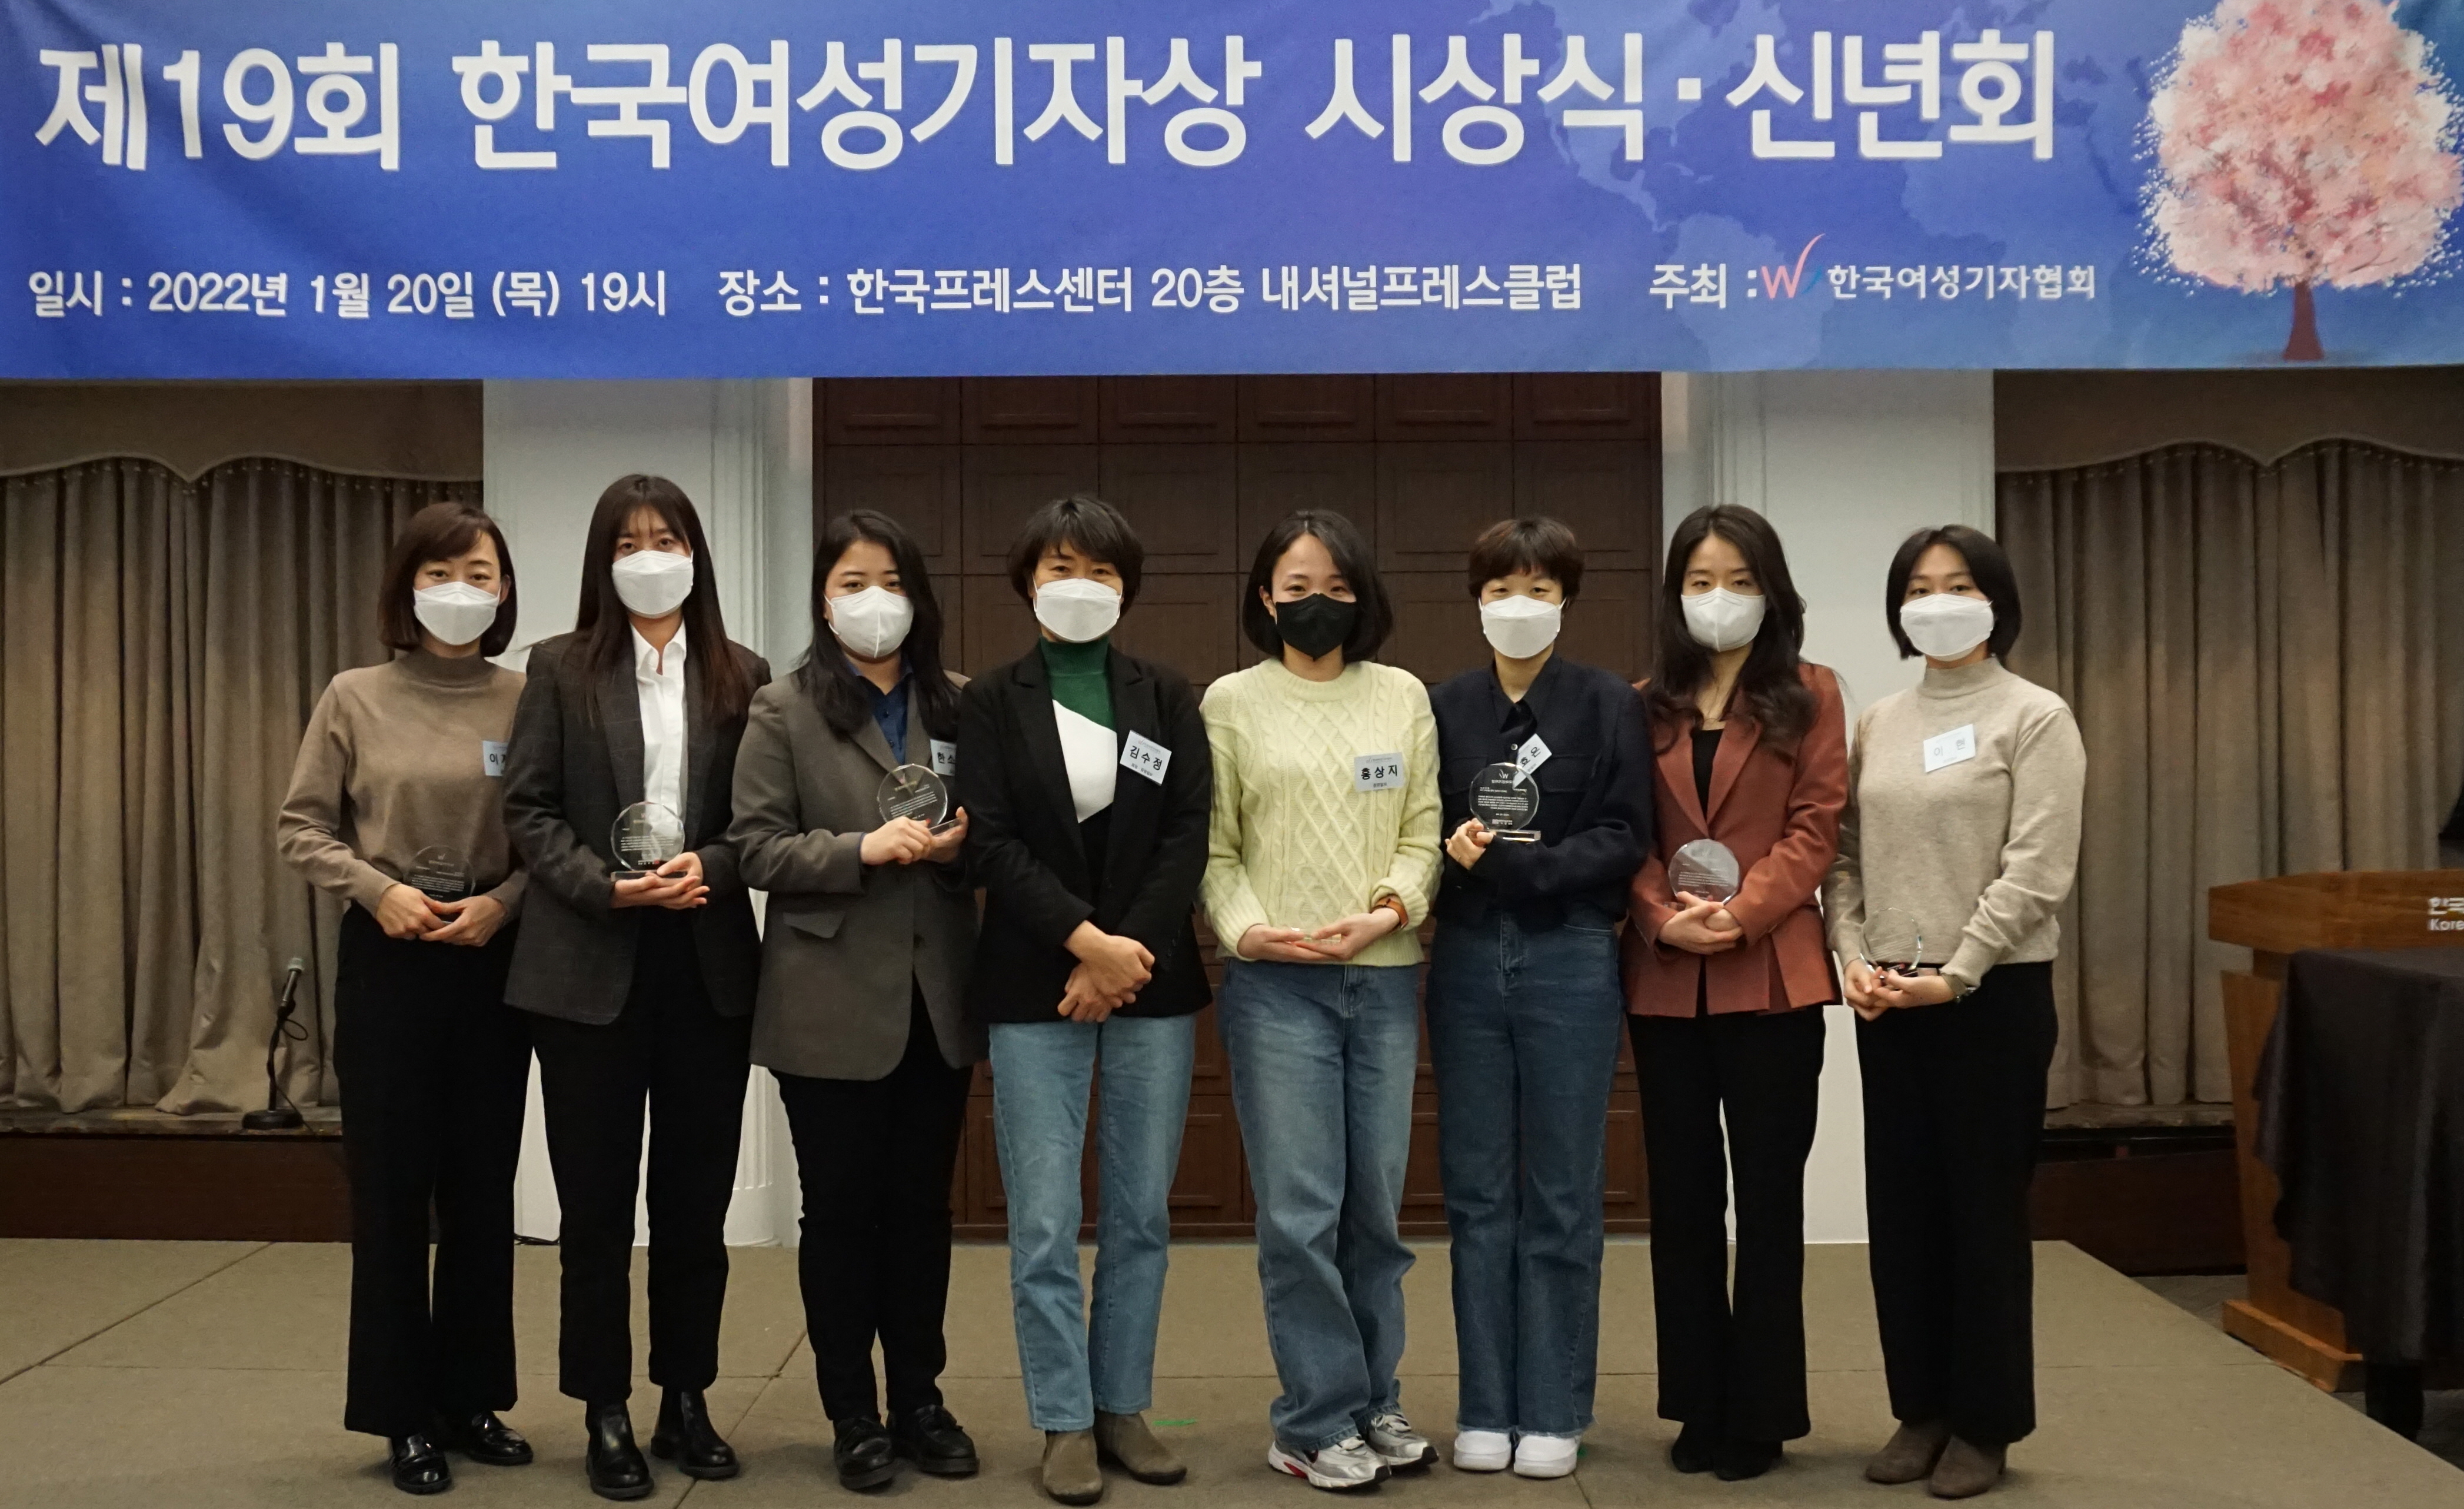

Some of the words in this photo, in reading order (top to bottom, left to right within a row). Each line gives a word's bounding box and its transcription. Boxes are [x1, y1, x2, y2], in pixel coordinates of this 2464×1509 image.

[35, 42, 400, 171] 제19회
[452, 35, 1263, 170] 한국여성기자상
[29, 271, 102, 317] 일시
[122, 278, 132, 305] :
[148, 272, 287, 317] 2022년
[311, 272, 369, 318] 1월
[388, 272, 474, 318] 20일
[492, 271, 560, 317] (목)
[581, 270, 665, 316] 19시
[718, 270, 802, 317] 장소
[819, 277, 829, 304] :
[847, 267, 1132, 314] 한국프레스센터
[1151, 264, 1245, 314] 20층
[1261, 263, 1581, 313] 내셔널프레스클럽
[1649, 262, 1728, 310] 주최
[1827, 264, 2096, 301] 한국여성기자협회
[1130, 745, 1163, 770] 김수정
[1361, 765, 1397, 780] 홍상지
